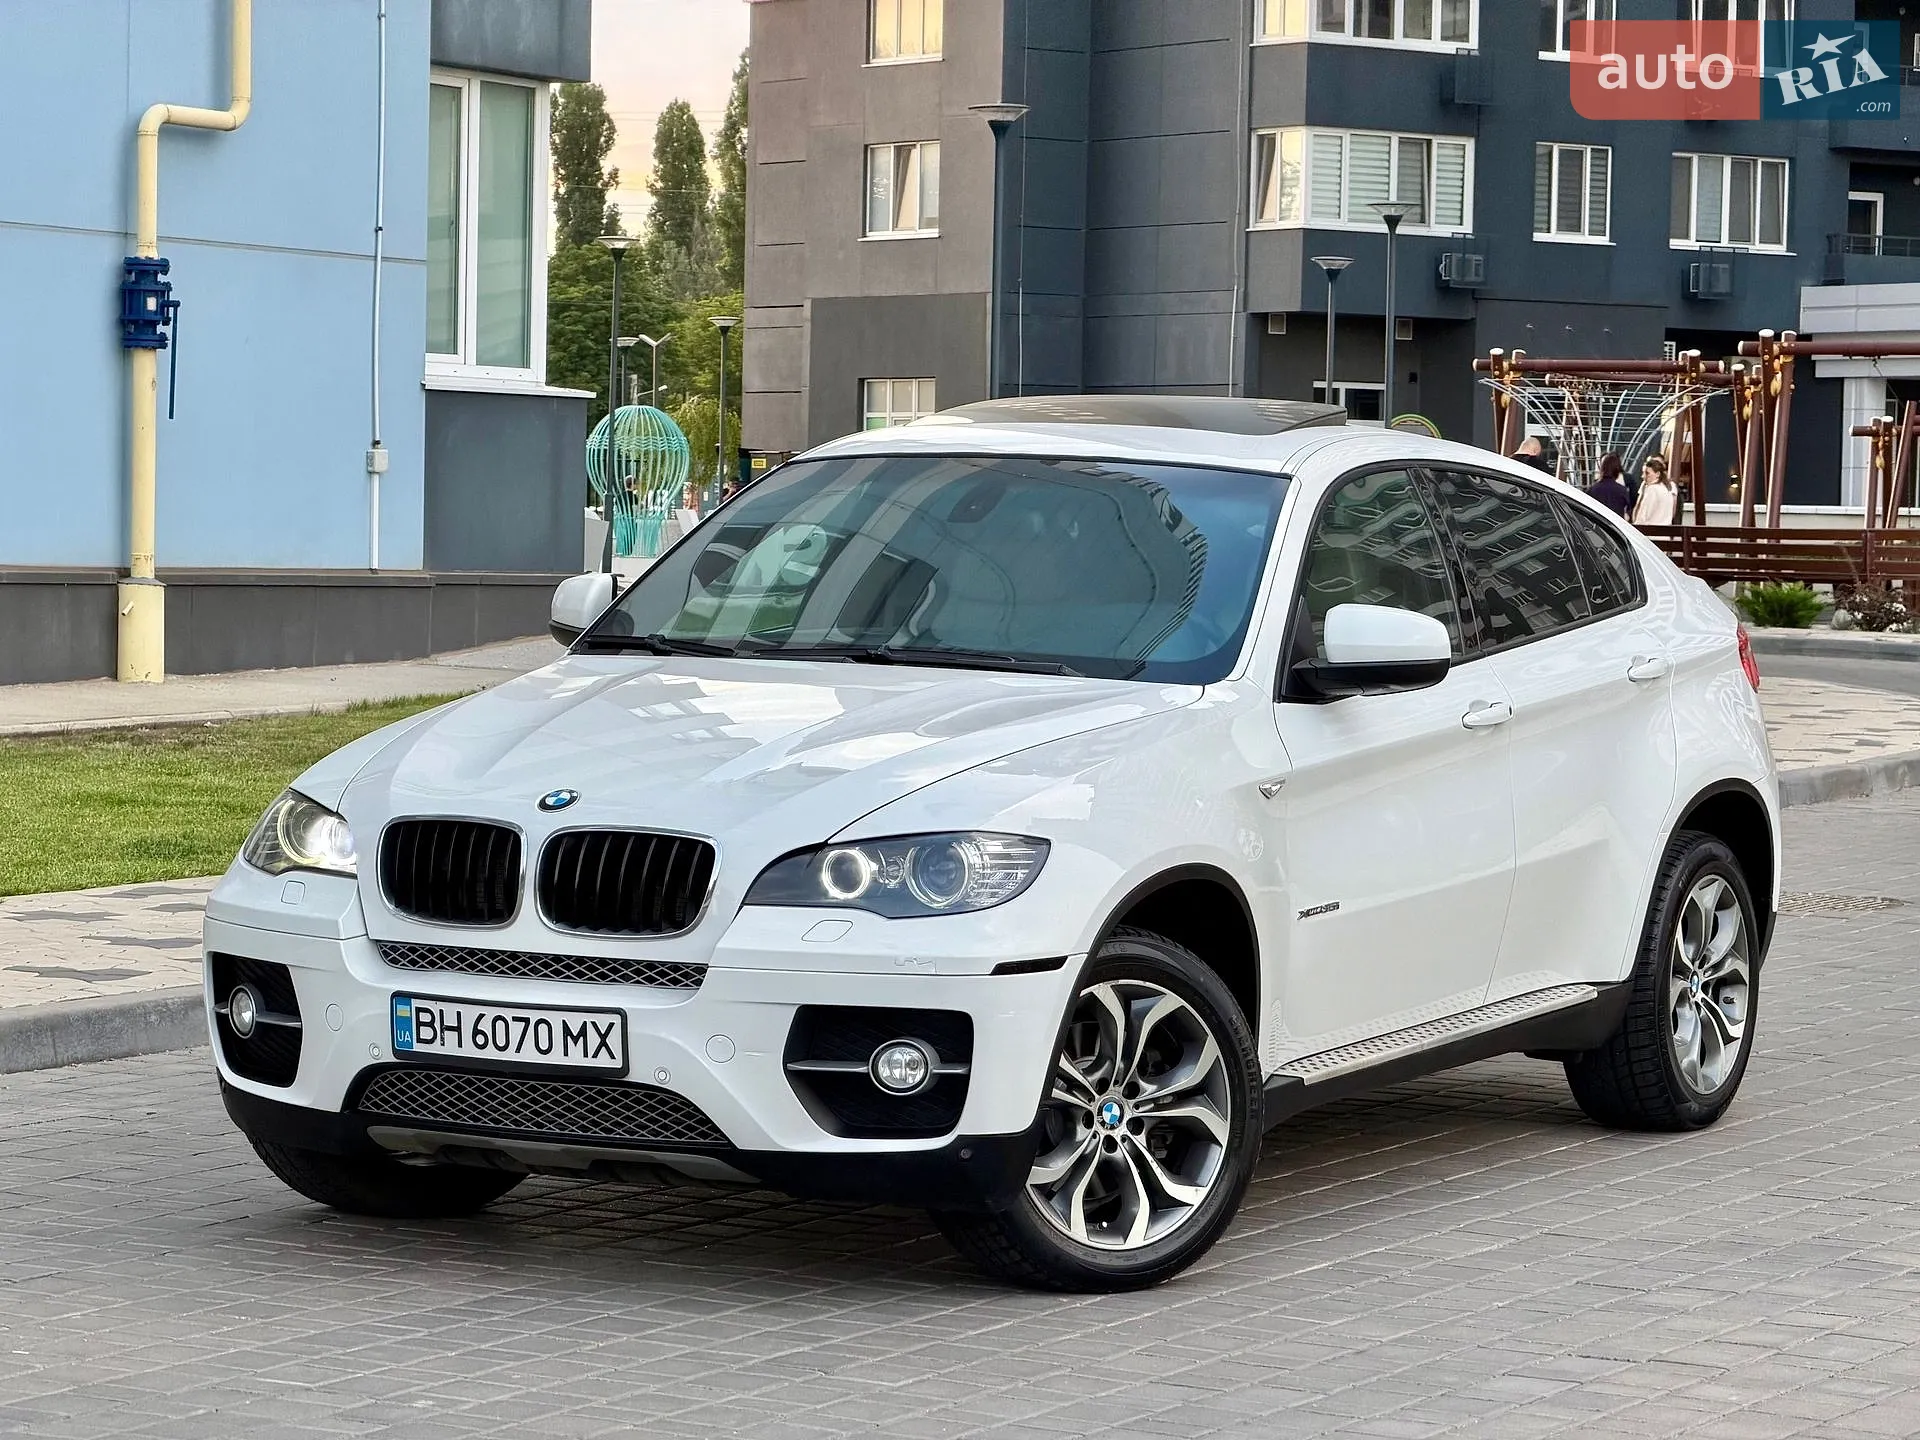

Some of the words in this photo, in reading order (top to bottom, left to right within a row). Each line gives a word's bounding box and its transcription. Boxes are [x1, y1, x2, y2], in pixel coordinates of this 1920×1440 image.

[396, 1030, 411, 1042] UA
[414, 1006, 463, 1049] BH
[471, 1013, 553, 1056] 6070
[561, 1019, 617, 1060] MX
